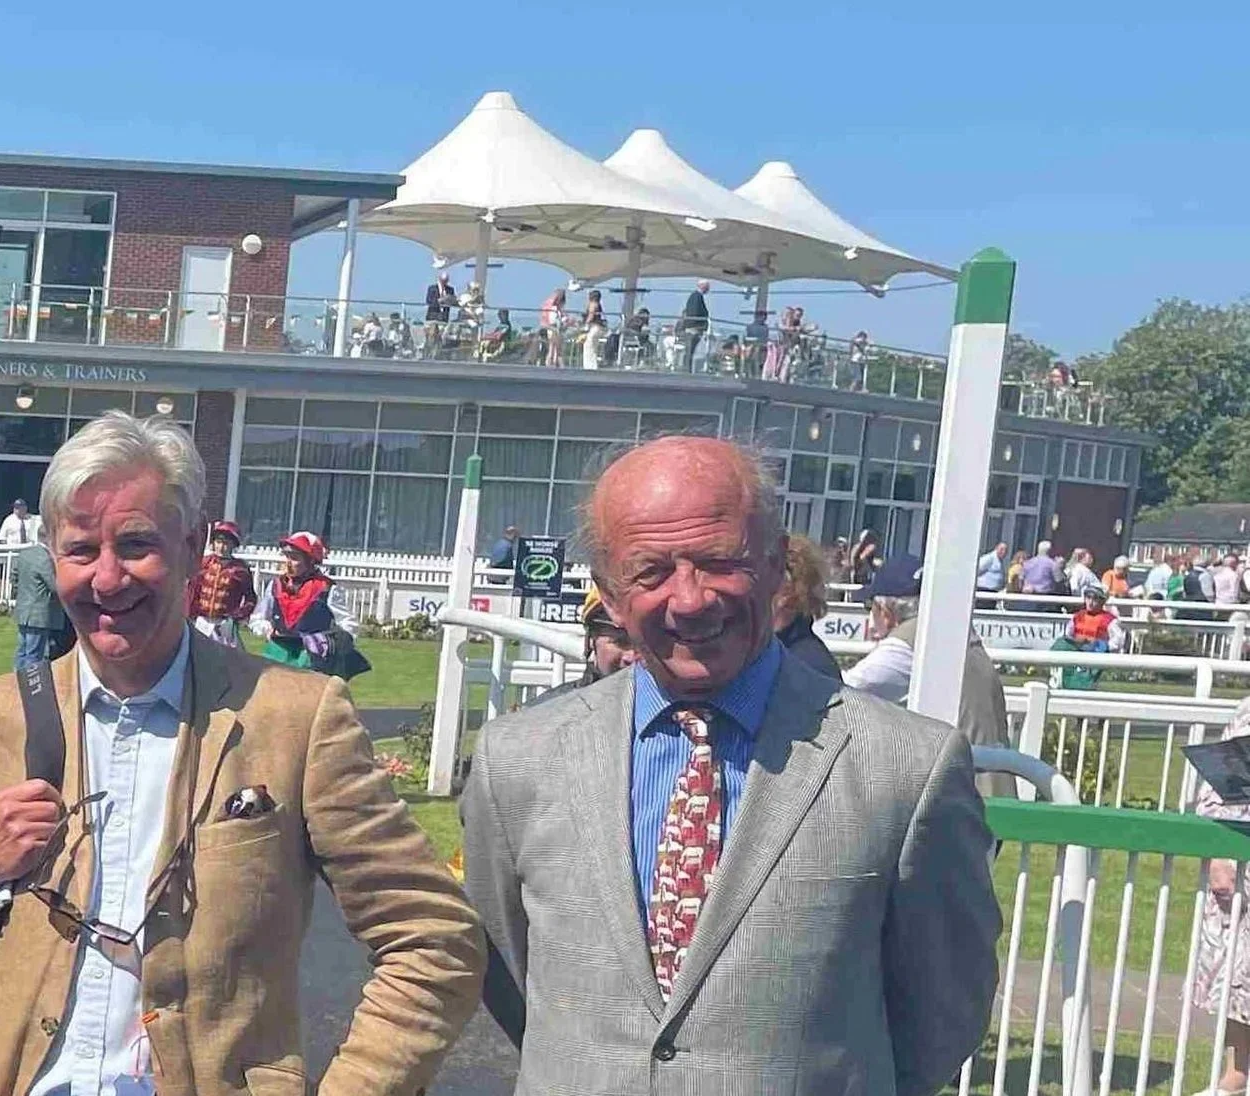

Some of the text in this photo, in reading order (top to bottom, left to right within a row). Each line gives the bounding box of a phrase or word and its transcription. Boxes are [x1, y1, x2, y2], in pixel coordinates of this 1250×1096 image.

[42, 363, 55, 379] &
[64, 363, 147, 382] TRAINERS
[409, 596, 445, 617] sky
[825, 617, 862, 639] sky
